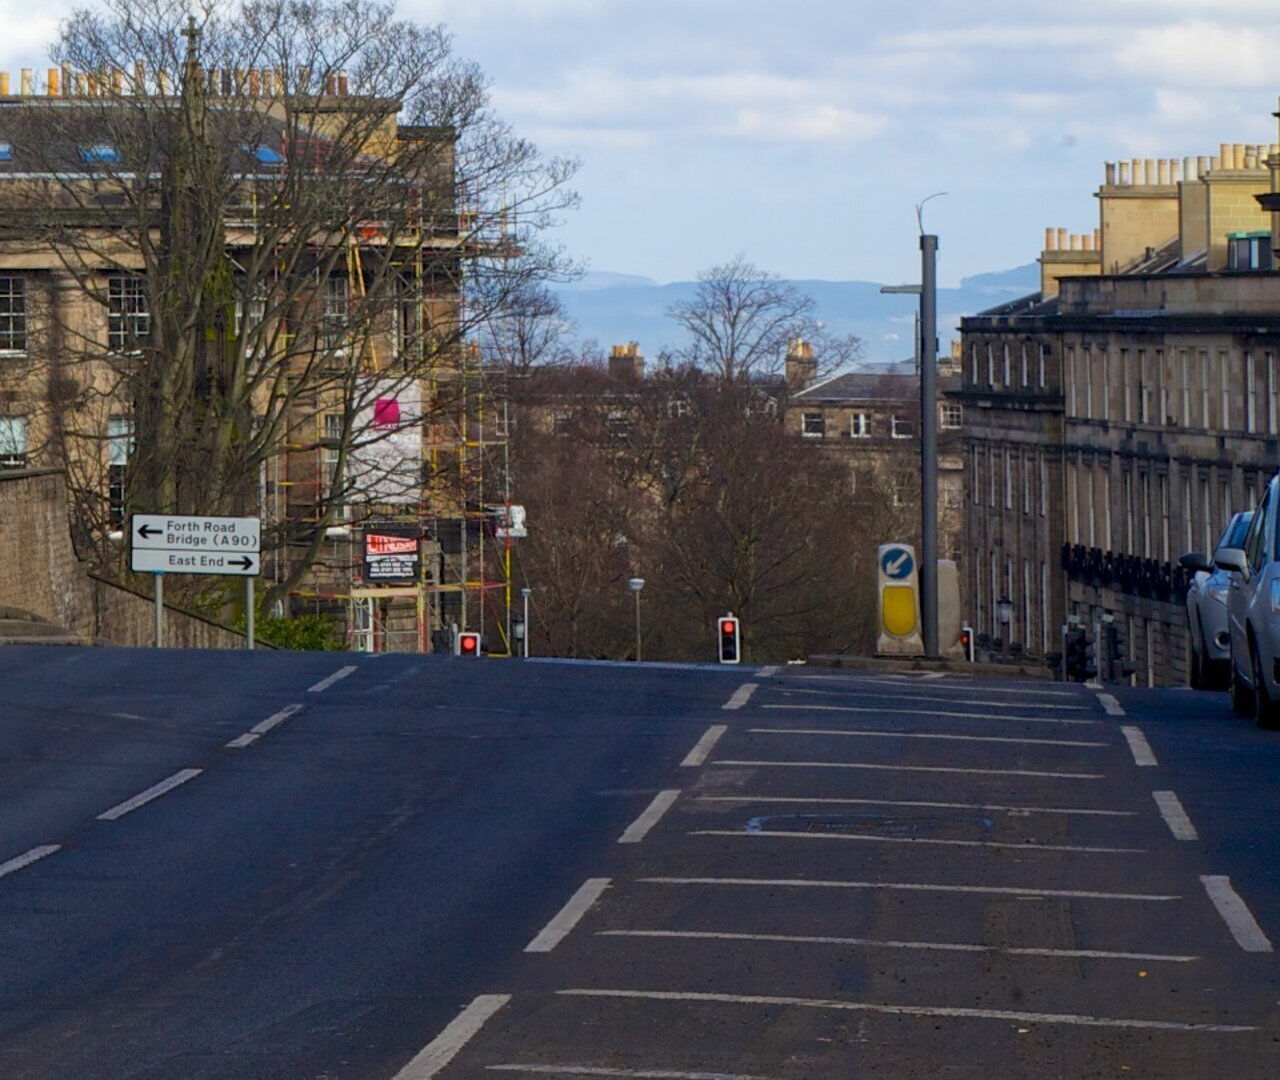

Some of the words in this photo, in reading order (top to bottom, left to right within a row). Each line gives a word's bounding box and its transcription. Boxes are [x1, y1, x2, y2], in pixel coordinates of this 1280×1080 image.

[167, 520, 200, 532] Forth
[203, 522, 236, 533] Road
[167, 533, 207, 547] Bridge
[213, 534, 257, 547] (A90)
[168, 555, 196, 566] East
[200, 556, 224, 567] End
